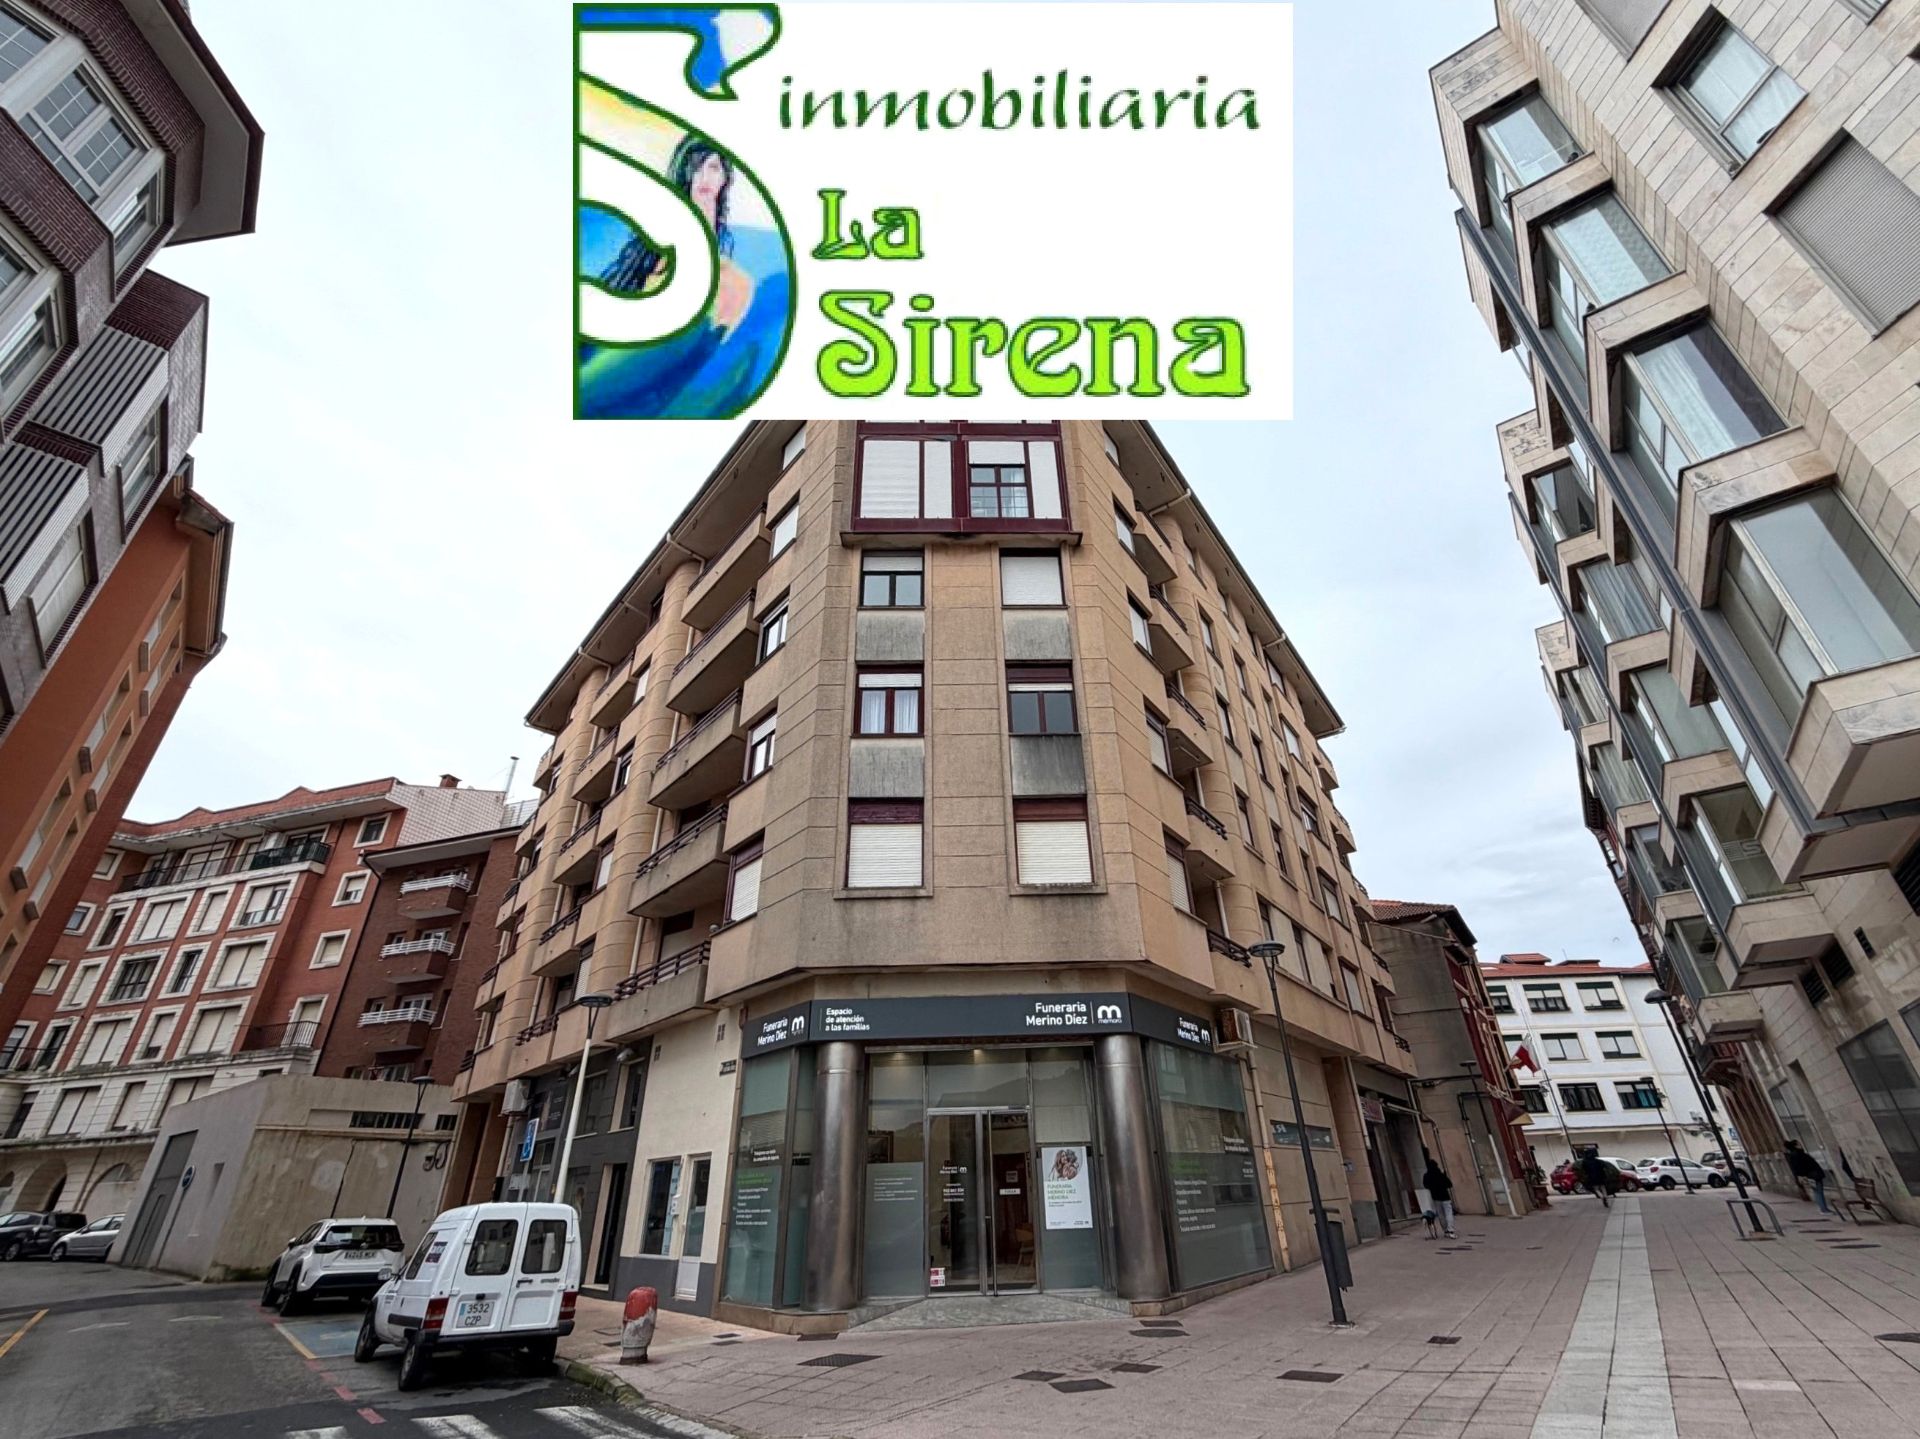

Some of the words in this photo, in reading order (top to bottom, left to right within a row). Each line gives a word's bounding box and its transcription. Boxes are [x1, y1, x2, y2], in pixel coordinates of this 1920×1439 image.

[826, 1007, 853, 1016] Espacio
[1035, 1001, 1087, 1013] Funeraria
[825, 1015, 835, 1024] de
[836, 1014, 865, 1023] atención
[1025, 1014, 1063, 1026] Merino
[1064, 1013, 1088, 1025] Díez
[762, 1017, 788, 1033] Funeraria
[831, 1023, 842, 1031] las
[843, 1023, 870, 1031] familias
[757, 1031, 775, 1047] Merino
[467, 1303, 490, 1314] 3532
[464, 1315, 482, 1326] CZP
